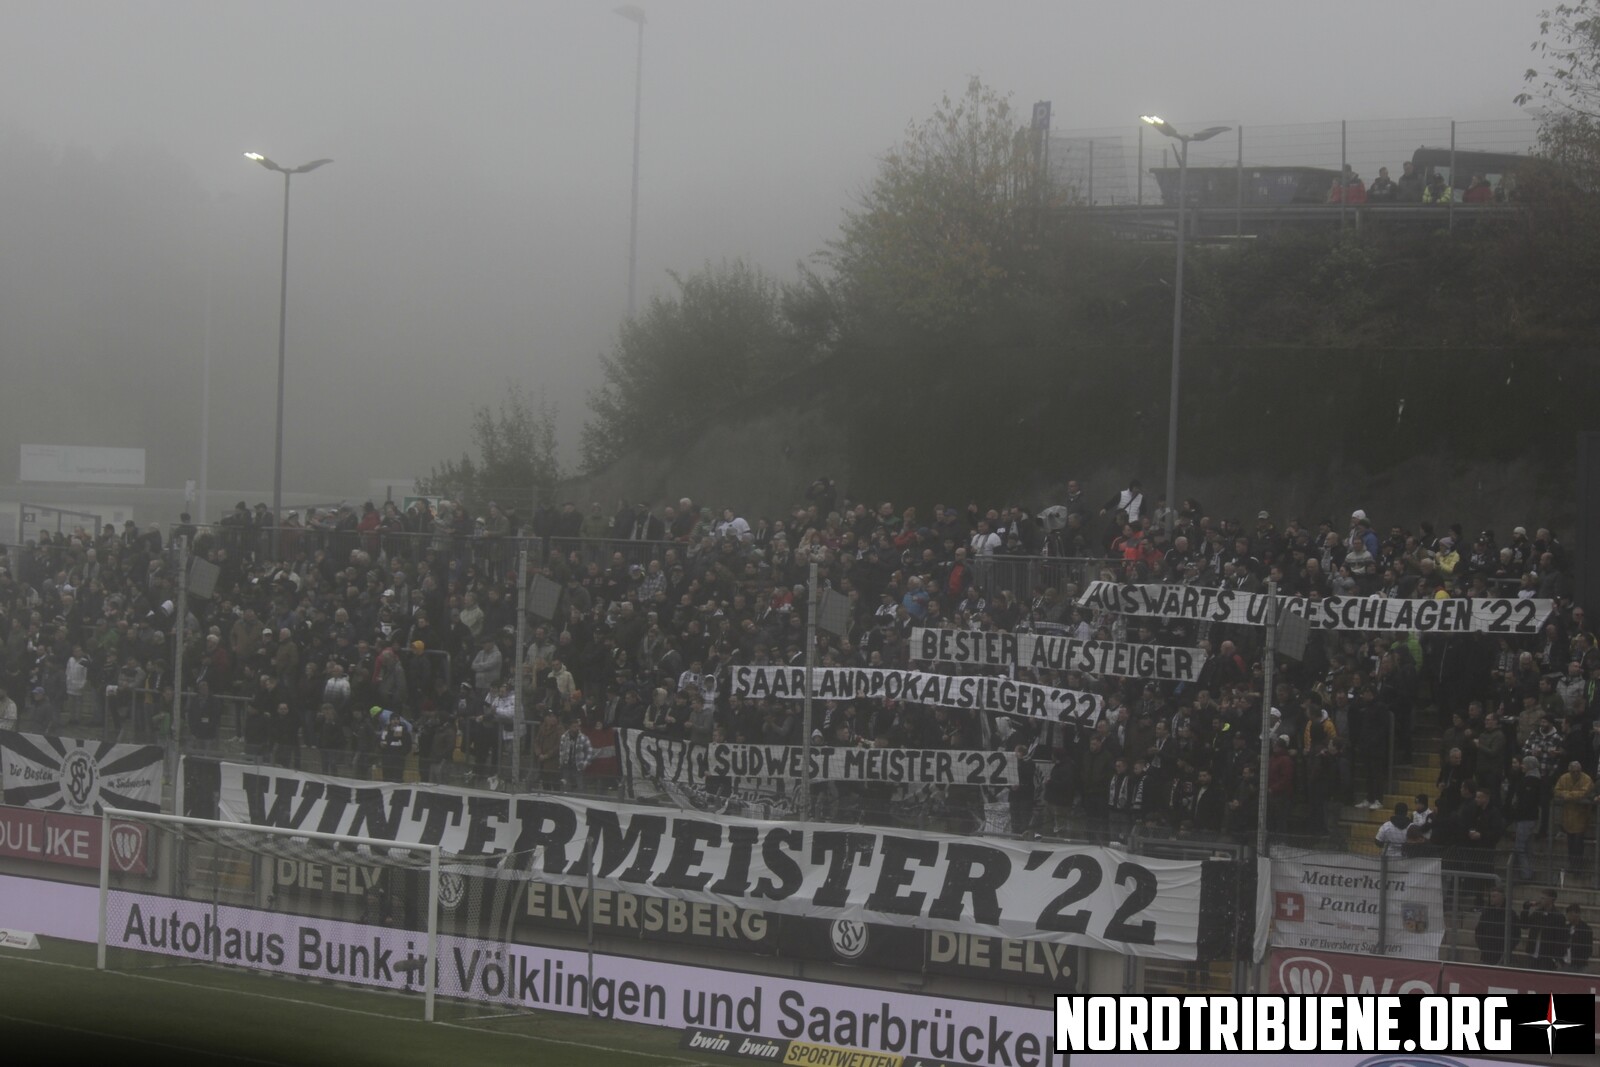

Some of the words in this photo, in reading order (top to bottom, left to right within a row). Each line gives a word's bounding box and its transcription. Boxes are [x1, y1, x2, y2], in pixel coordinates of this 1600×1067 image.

[1084, 582, 1235, 622] AUSWÄRTS
[921, 628, 1016, 664] BESTER
[1031, 635, 1194, 680] AUFSTEIGER
[713, 741, 834, 779] SÜDWEST
[277, 859, 324, 890] DIE
[1300, 870, 1407, 892] Matterhorn
[526, 883, 769, 942] ELVERSBERG
[122, 902, 287, 967] Autohaus
[298, 927, 393, 981] Bunk
[452, 946, 666, 1023] Völklingen
[682, 987, 762, 1033] und
[930, 929, 991, 968] DIE
[689, 1032, 730, 1052] bwin
[738, 1039, 780, 1058] bwin
[787, 1044, 899, 1067] SPORTWETTEN
